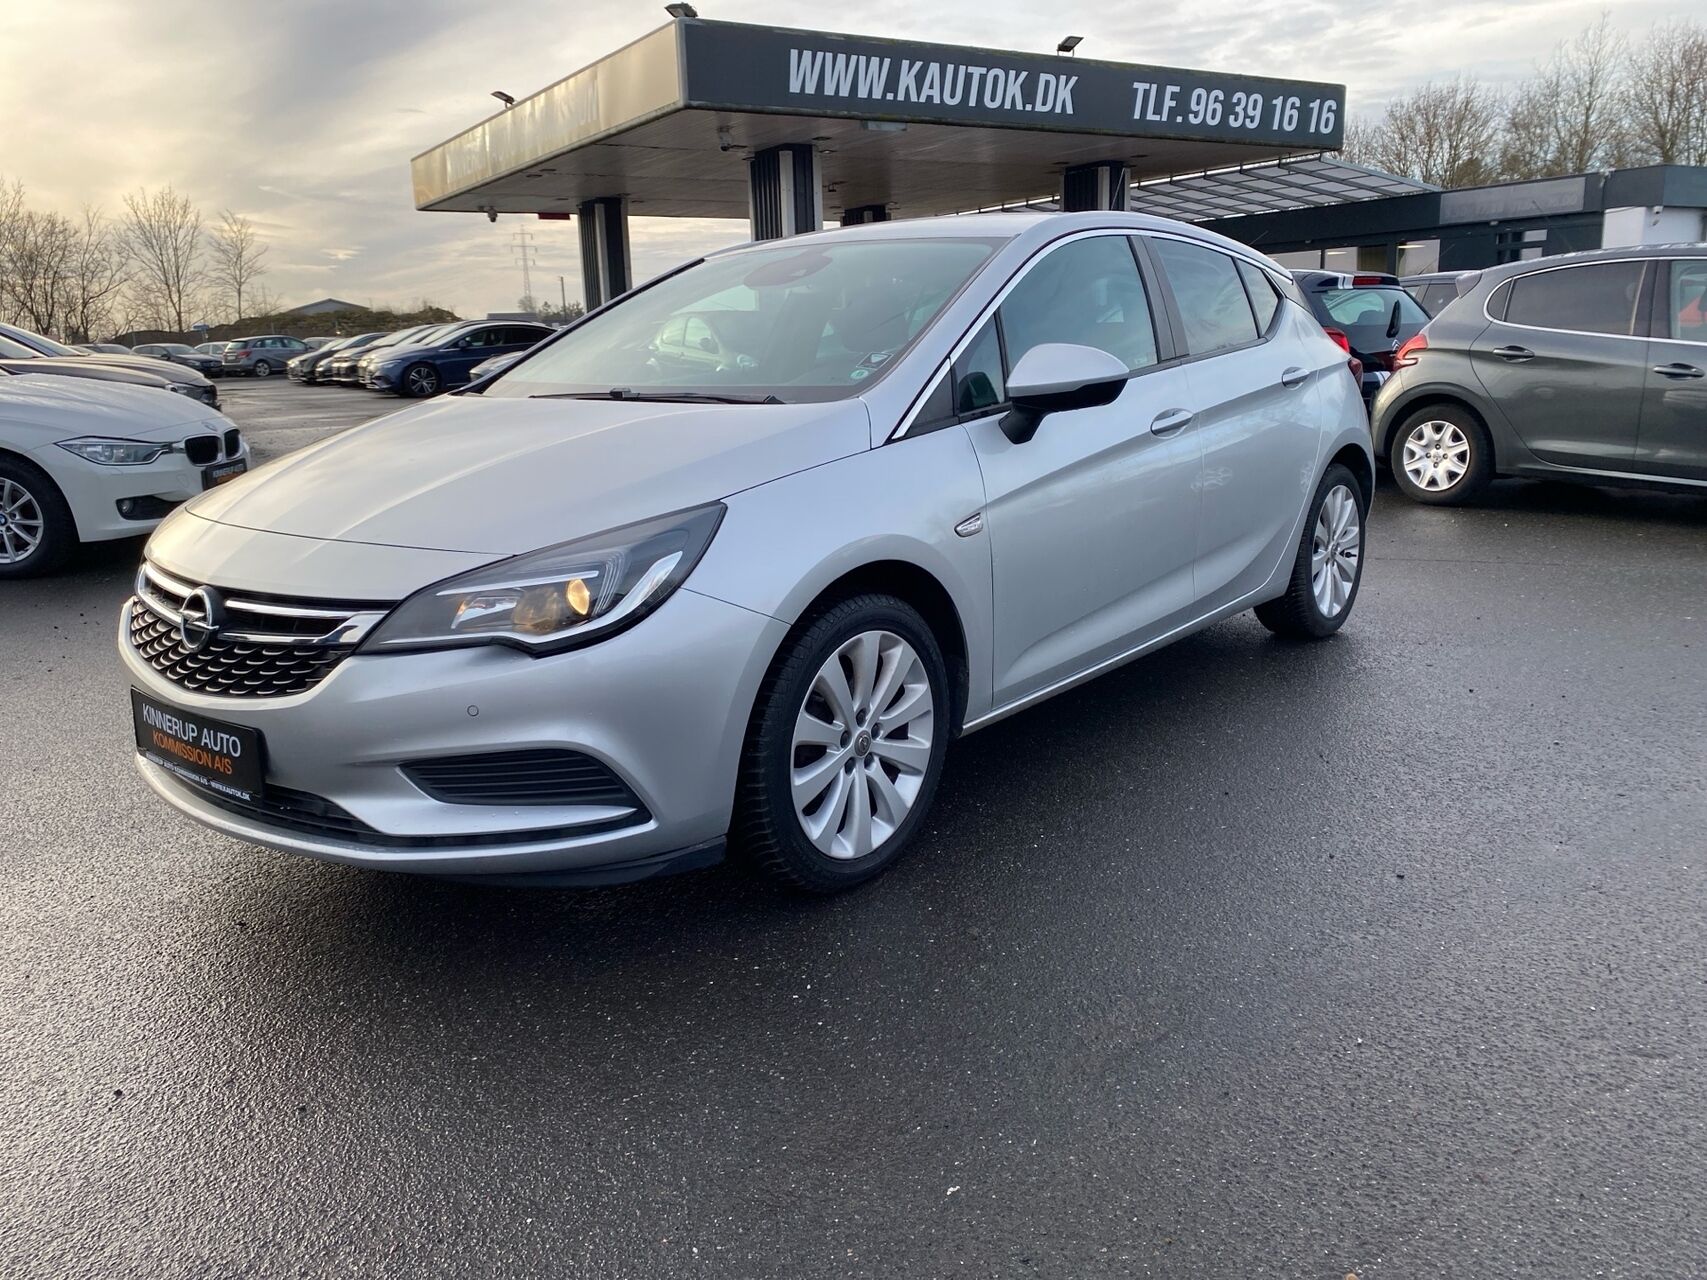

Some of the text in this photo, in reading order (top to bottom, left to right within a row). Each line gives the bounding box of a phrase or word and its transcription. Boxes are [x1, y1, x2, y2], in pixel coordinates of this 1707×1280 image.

[788, 48, 1079, 115] WWW.KAUTOK.DK
[1132, 81, 1337, 135] TLF. 96 39 16 16
[142, 703, 241, 757] KINNERUP AUTO
[152, 730, 212, 769] KOMMISSION
[213, 756, 233, 775] A/S
